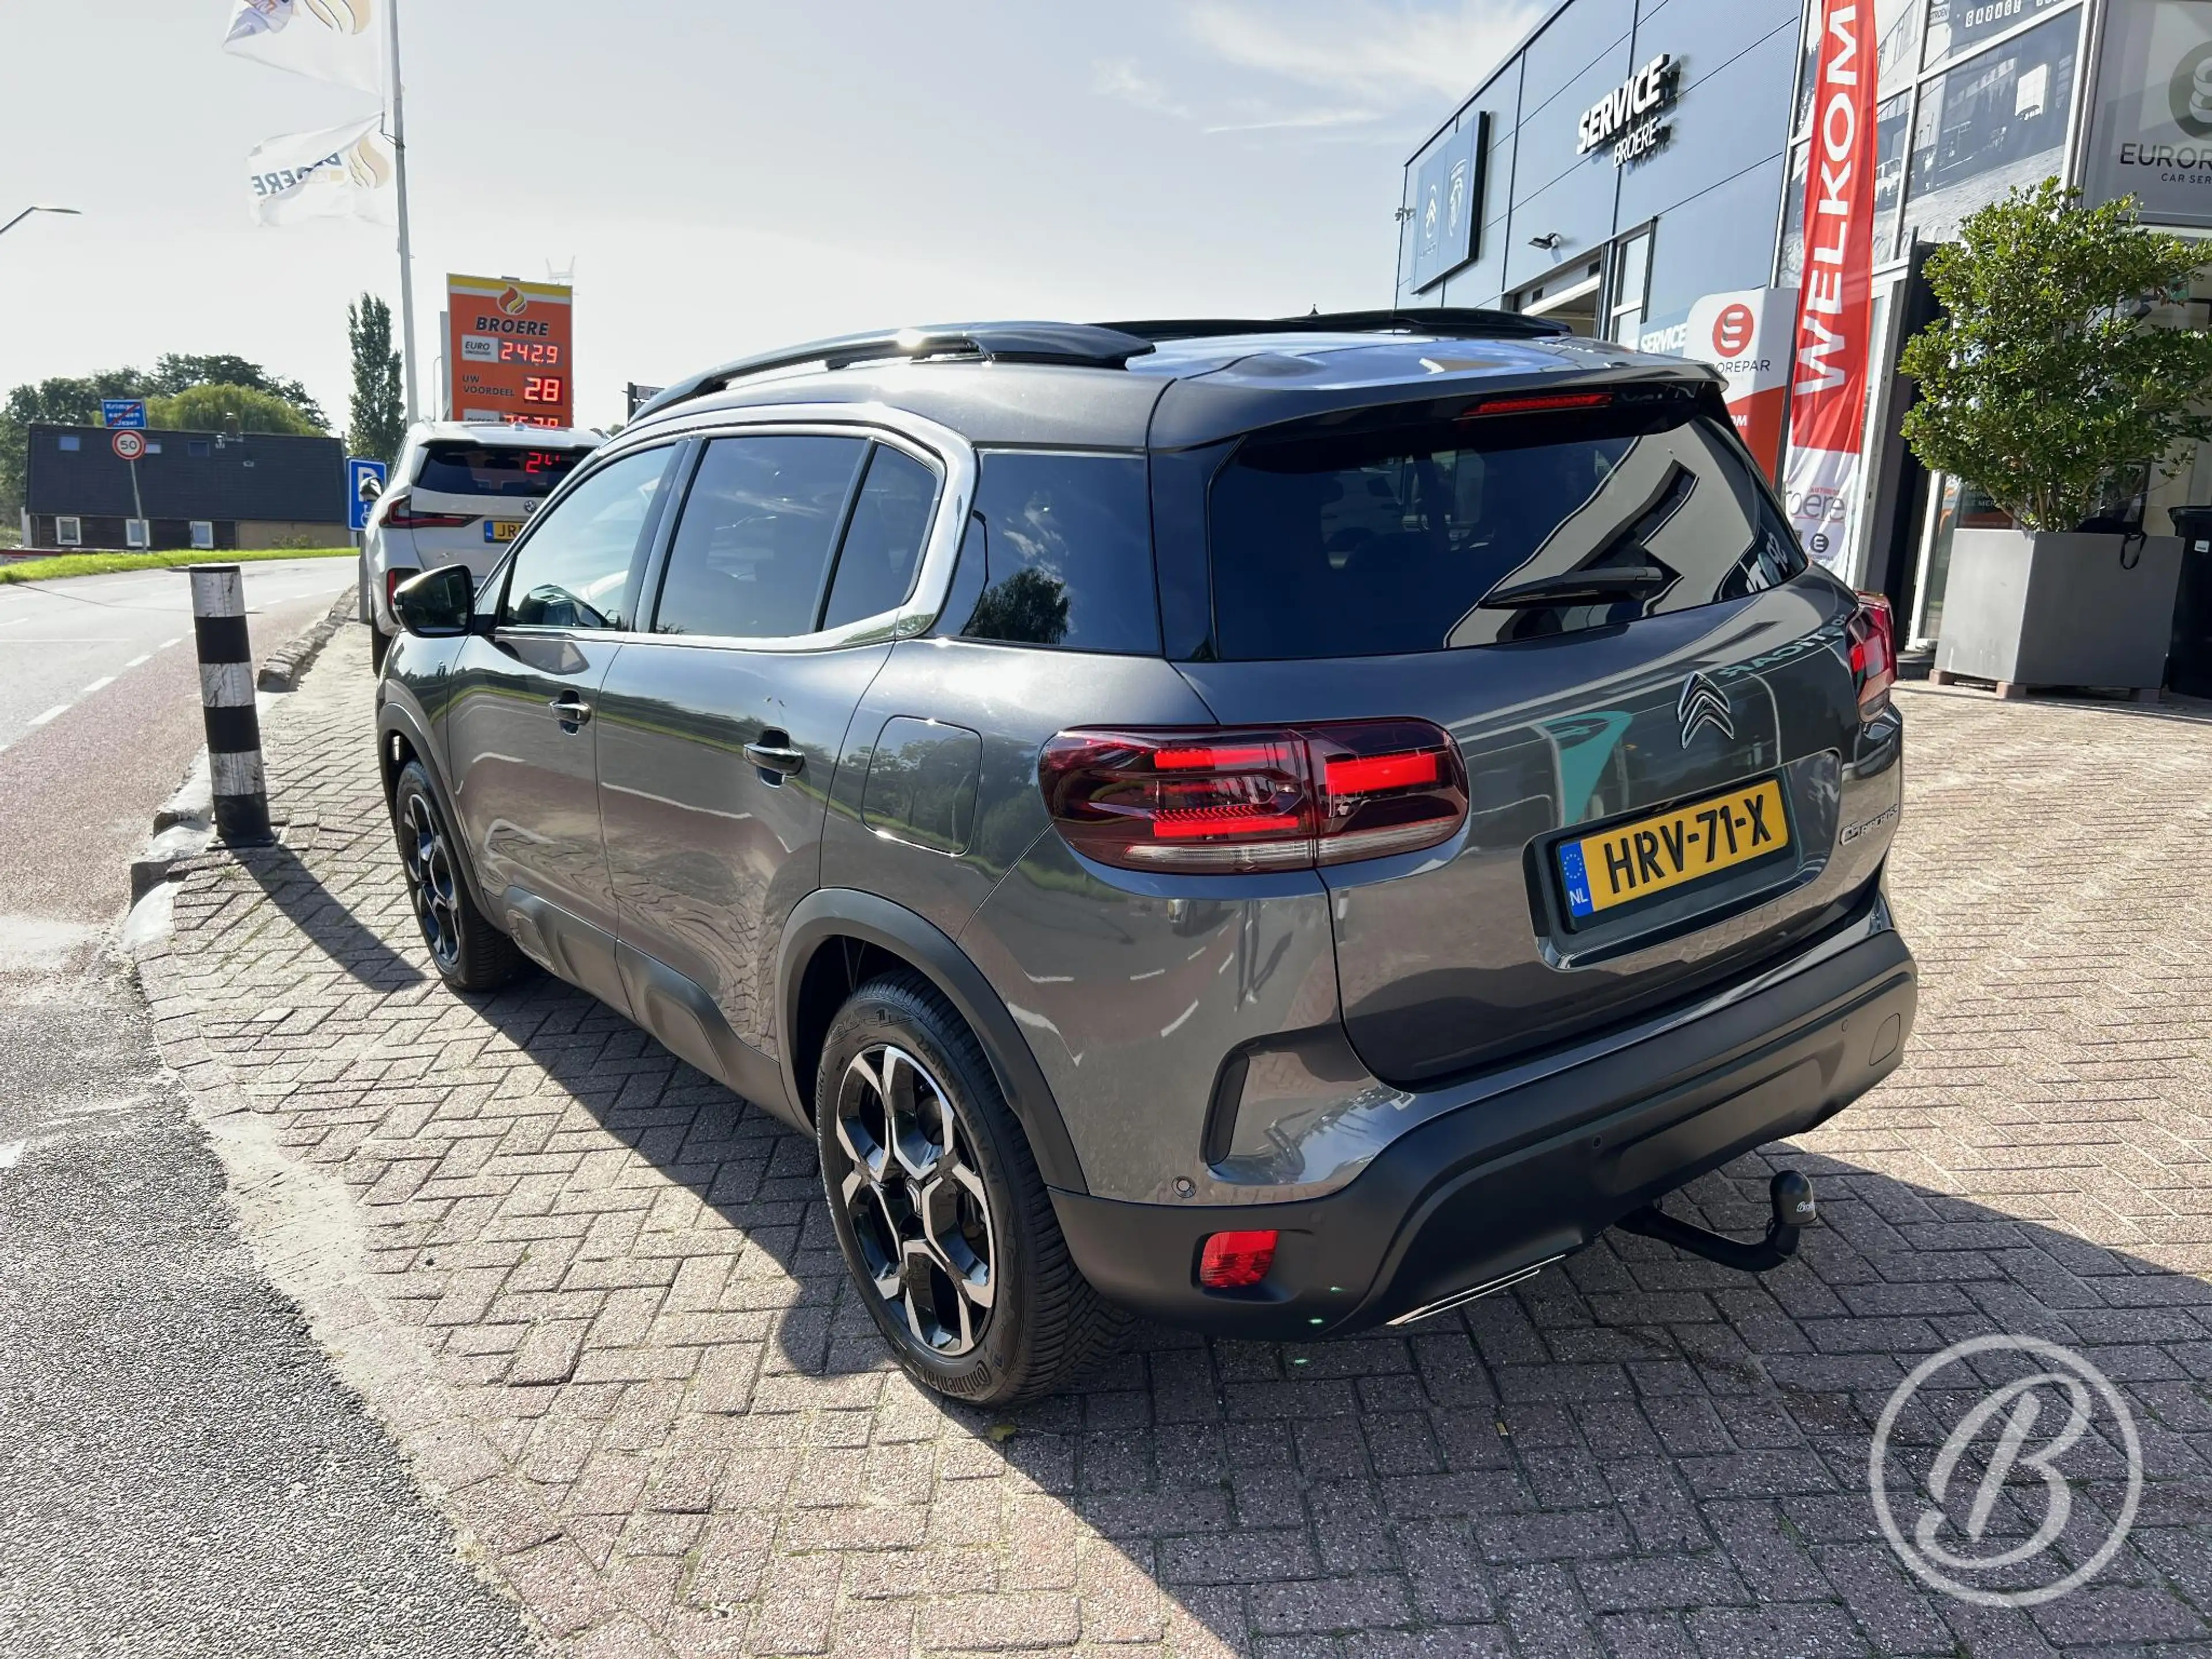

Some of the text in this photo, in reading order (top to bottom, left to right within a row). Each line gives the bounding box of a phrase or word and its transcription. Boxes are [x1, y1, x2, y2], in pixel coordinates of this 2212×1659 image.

[1576, 54, 1665, 155] SERVICE
[1613, 116, 1658, 168] BROERE
[2161, 173, 2185, 182] CAR
[1794, 3, 1857, 396] WELKOM
[475, 316, 549, 336] BROERE
[465, 340, 490, 351] EURO
[1641, 323, 1688, 354] SERVICE
[1713, 359, 1770, 373] OREPAR
[463, 374, 479, 383] UW
[463, 386, 515, 397] VOORDEEL
[524, 377, 559, 402] 28
[120, 441, 137, 449] 50
[1604, 795, 1771, 894] HRV-71-X
[1570, 888, 1588, 906] NL
[923, 1359, 993, 1396] Continental
